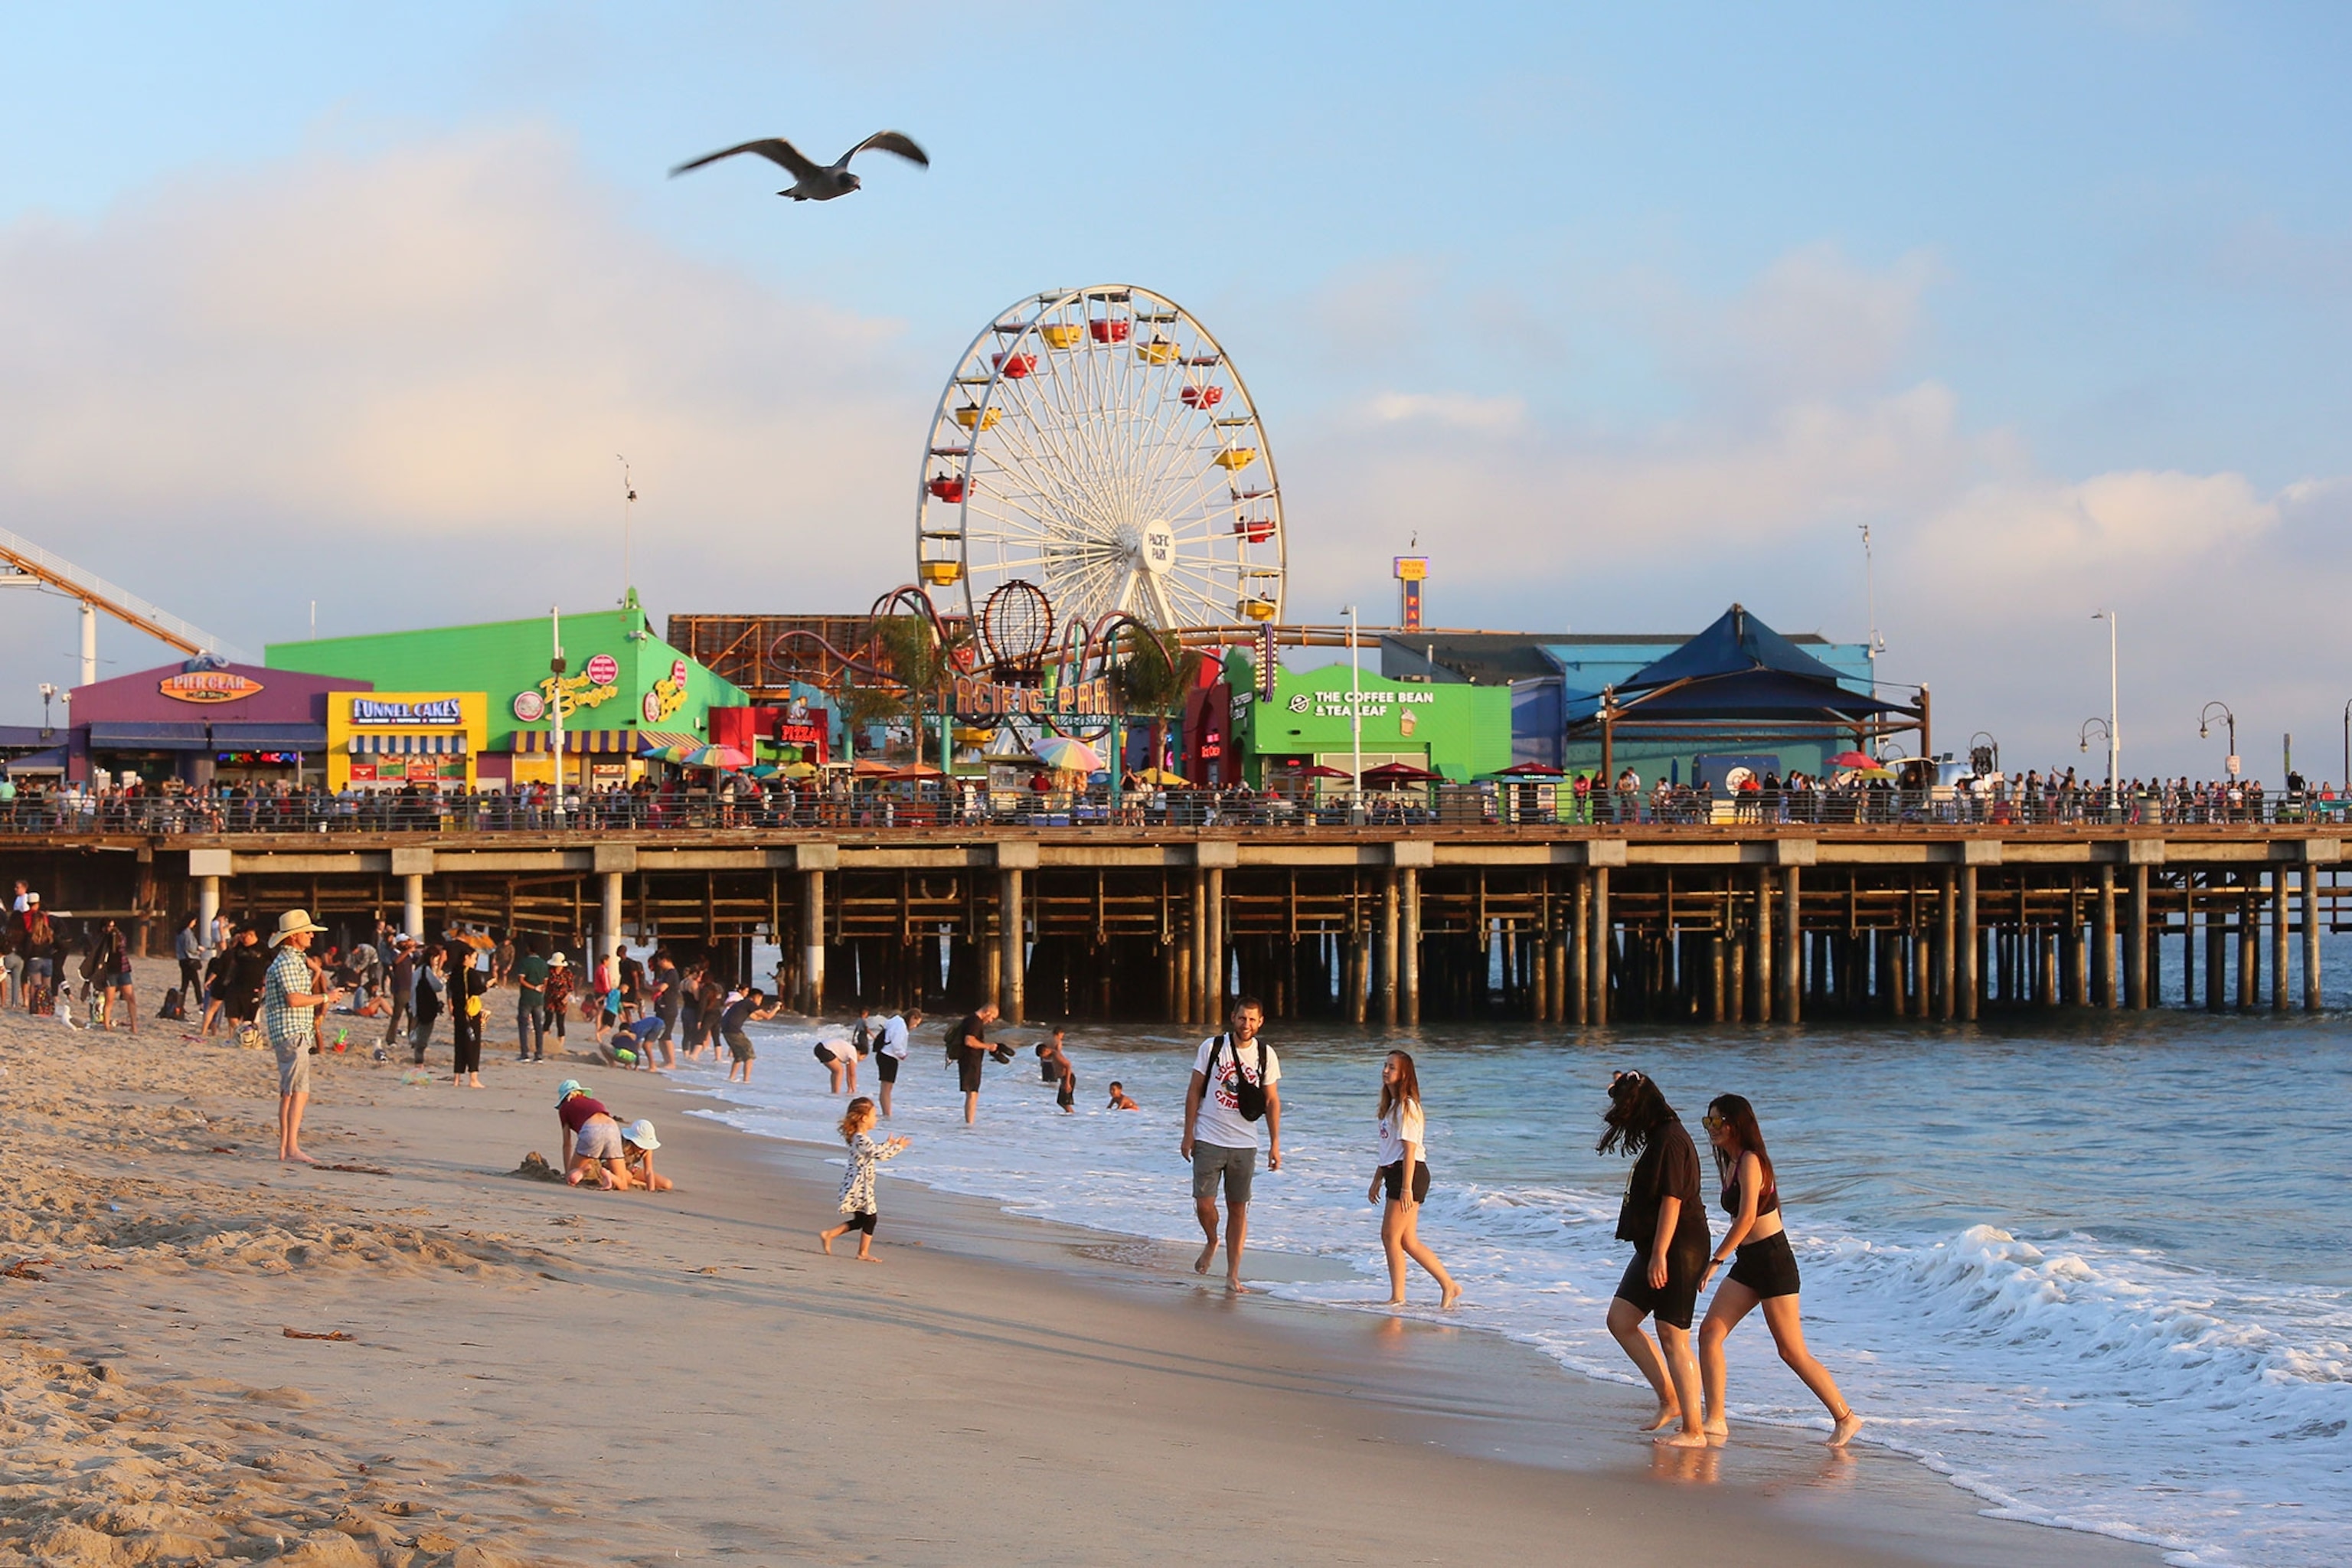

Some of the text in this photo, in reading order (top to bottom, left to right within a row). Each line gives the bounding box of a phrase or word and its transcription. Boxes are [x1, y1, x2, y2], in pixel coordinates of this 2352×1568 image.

[1149, 533, 1169, 547] PACIFIC
[1152, 547, 1166, 560] PARK
[173, 675, 205, 689] PIER
[938, 670, 1044, 714] PACIFIC
[1315, 692, 1340, 703] THE
[1397, 692, 1433, 703] BEAN
[354, 697, 460, 717] FUNNEL CAKES
[1326, 705, 1352, 717] TEA
[782, 725, 820, 742] PIZZA
[1976, 763, 1989, 773] 66
[1215, 1090, 1240, 1109] CARA
